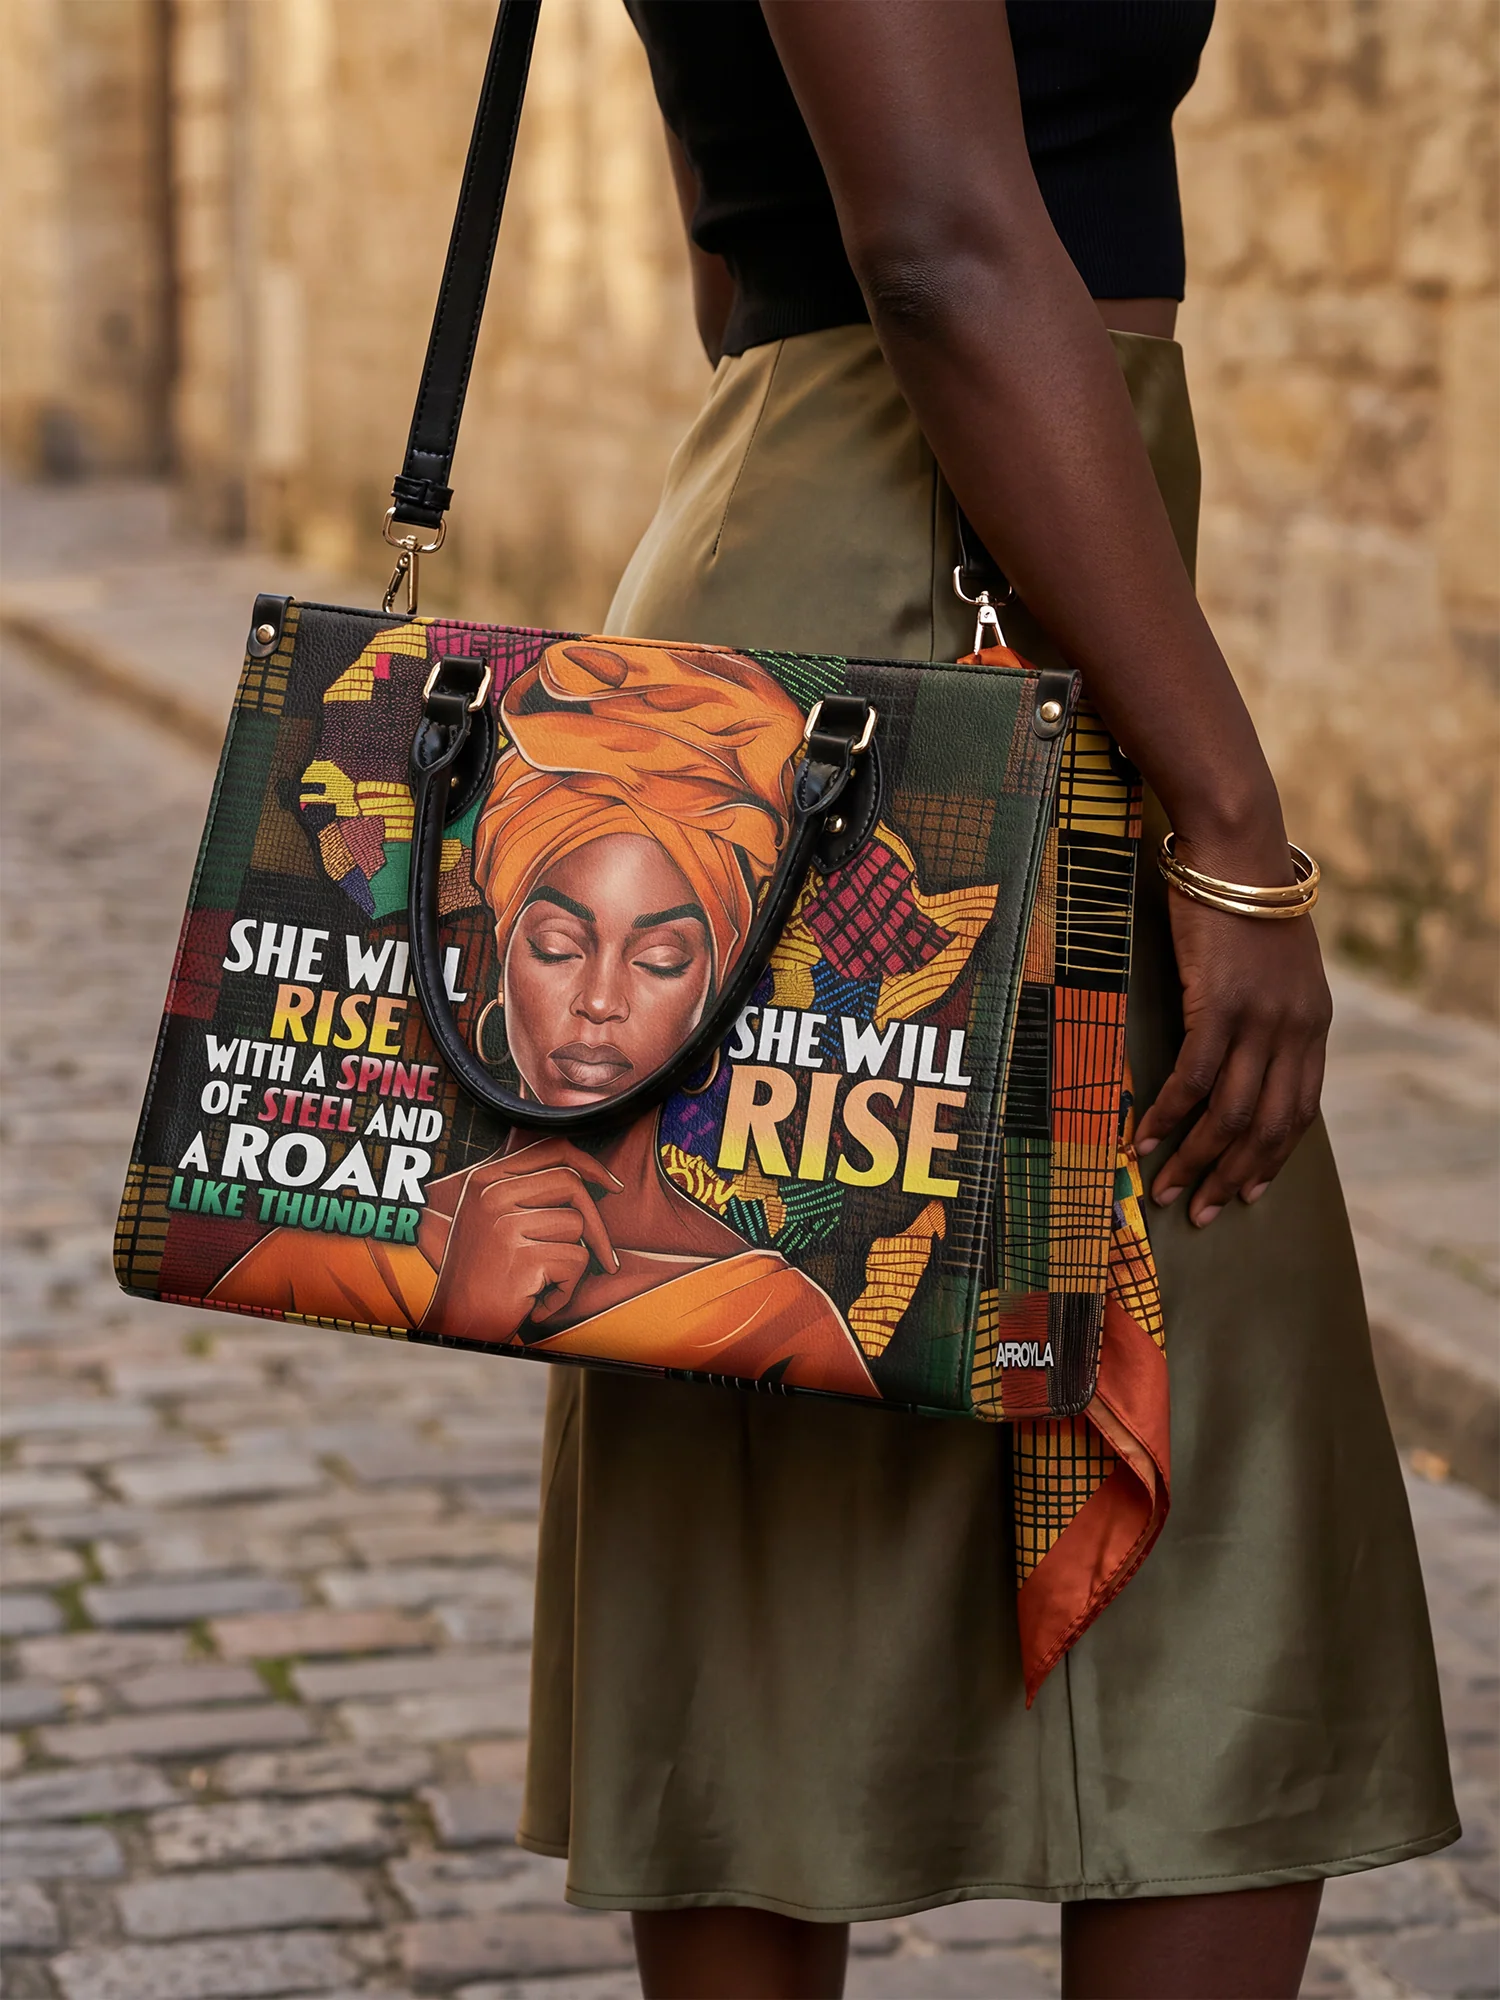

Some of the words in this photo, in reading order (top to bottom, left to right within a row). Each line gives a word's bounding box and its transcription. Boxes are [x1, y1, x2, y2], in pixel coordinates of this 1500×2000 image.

[222, 919, 329, 983] SHE
[346, 934, 467, 1002] WIL
[269, 984, 408, 1055] RISE
[728, 1005, 827, 1068] SHE
[841, 1016, 972, 1086] WILL
[205, 1034, 296, 1082] WITH
[301, 1051, 326, 1087] A
[336, 1055, 439, 1101] SPINE
[200, 1080, 251, 1116] OF
[258, 1087, 357, 1132] STEEL
[364, 1105, 443, 1143] AND
[717, 1064, 967, 1198] RISE
[178, 1130, 209, 1173] A
[221, 1123, 431, 1204] ROAR
[169, 1175, 247, 1218] LIKE
[258, 1188, 420, 1242] THUNDER
[995, 1342, 1054, 1367] AFROYLA
